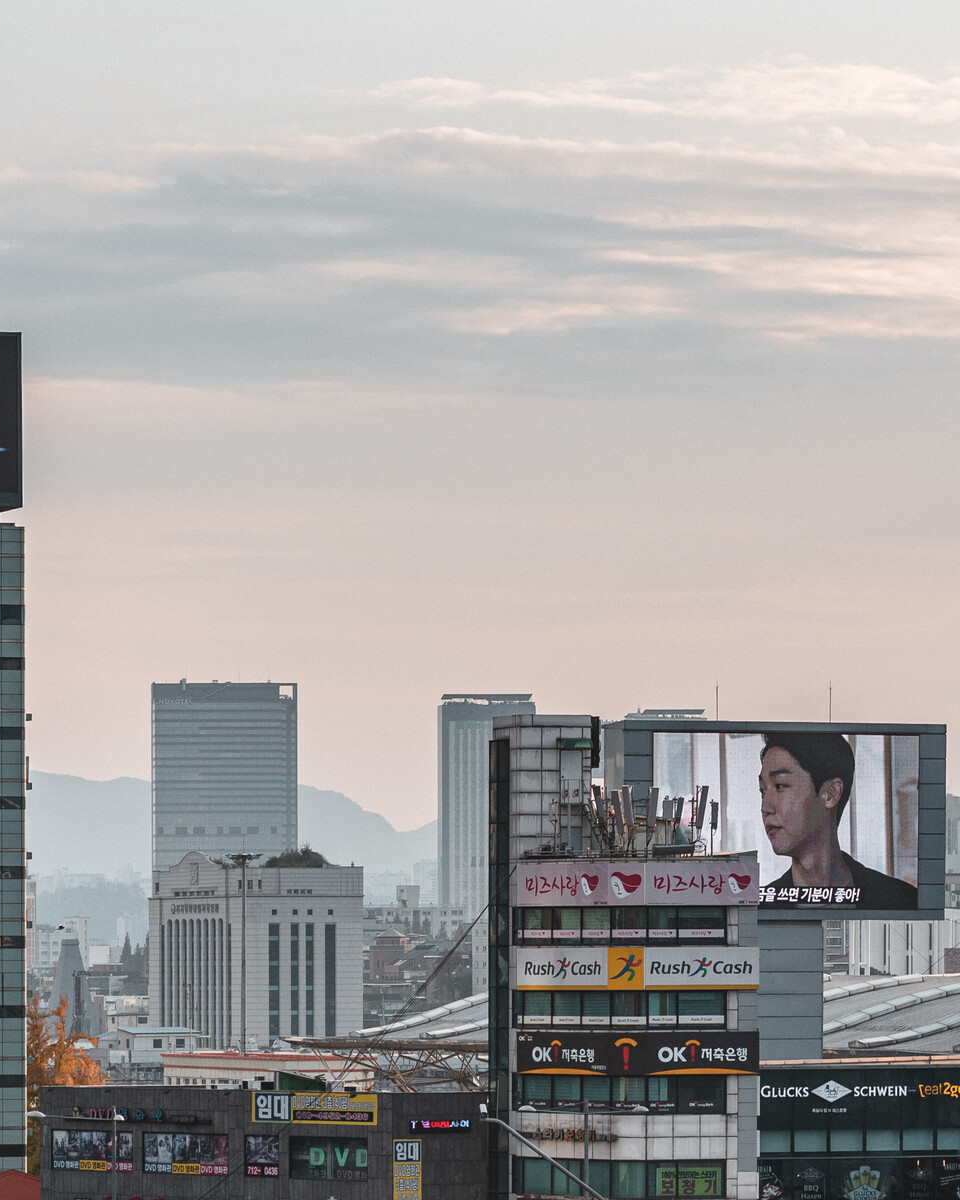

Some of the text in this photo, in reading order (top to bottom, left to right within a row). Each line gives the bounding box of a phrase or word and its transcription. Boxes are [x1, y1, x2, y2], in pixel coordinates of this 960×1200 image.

[525, 874, 580, 897] 미즈사랑
[653, 873, 727, 896] 미즈사랑
[777, 887, 799, 902] 쓰면
[800, 887, 833, 903] 기분이
[834, 887, 860, 903] 좋아!
[525, 961, 601, 976] Rush Cash
[650, 961, 753, 975] Rush Cash
[562, 1048, 595, 1063] 저축은행
[701, 1047, 748, 1062] 저축은행
[854, 1085, 907, 1097] SCHWEIN
[256, 1095, 289, 1119] 임대
[396, 1142, 419, 1160] 임대
